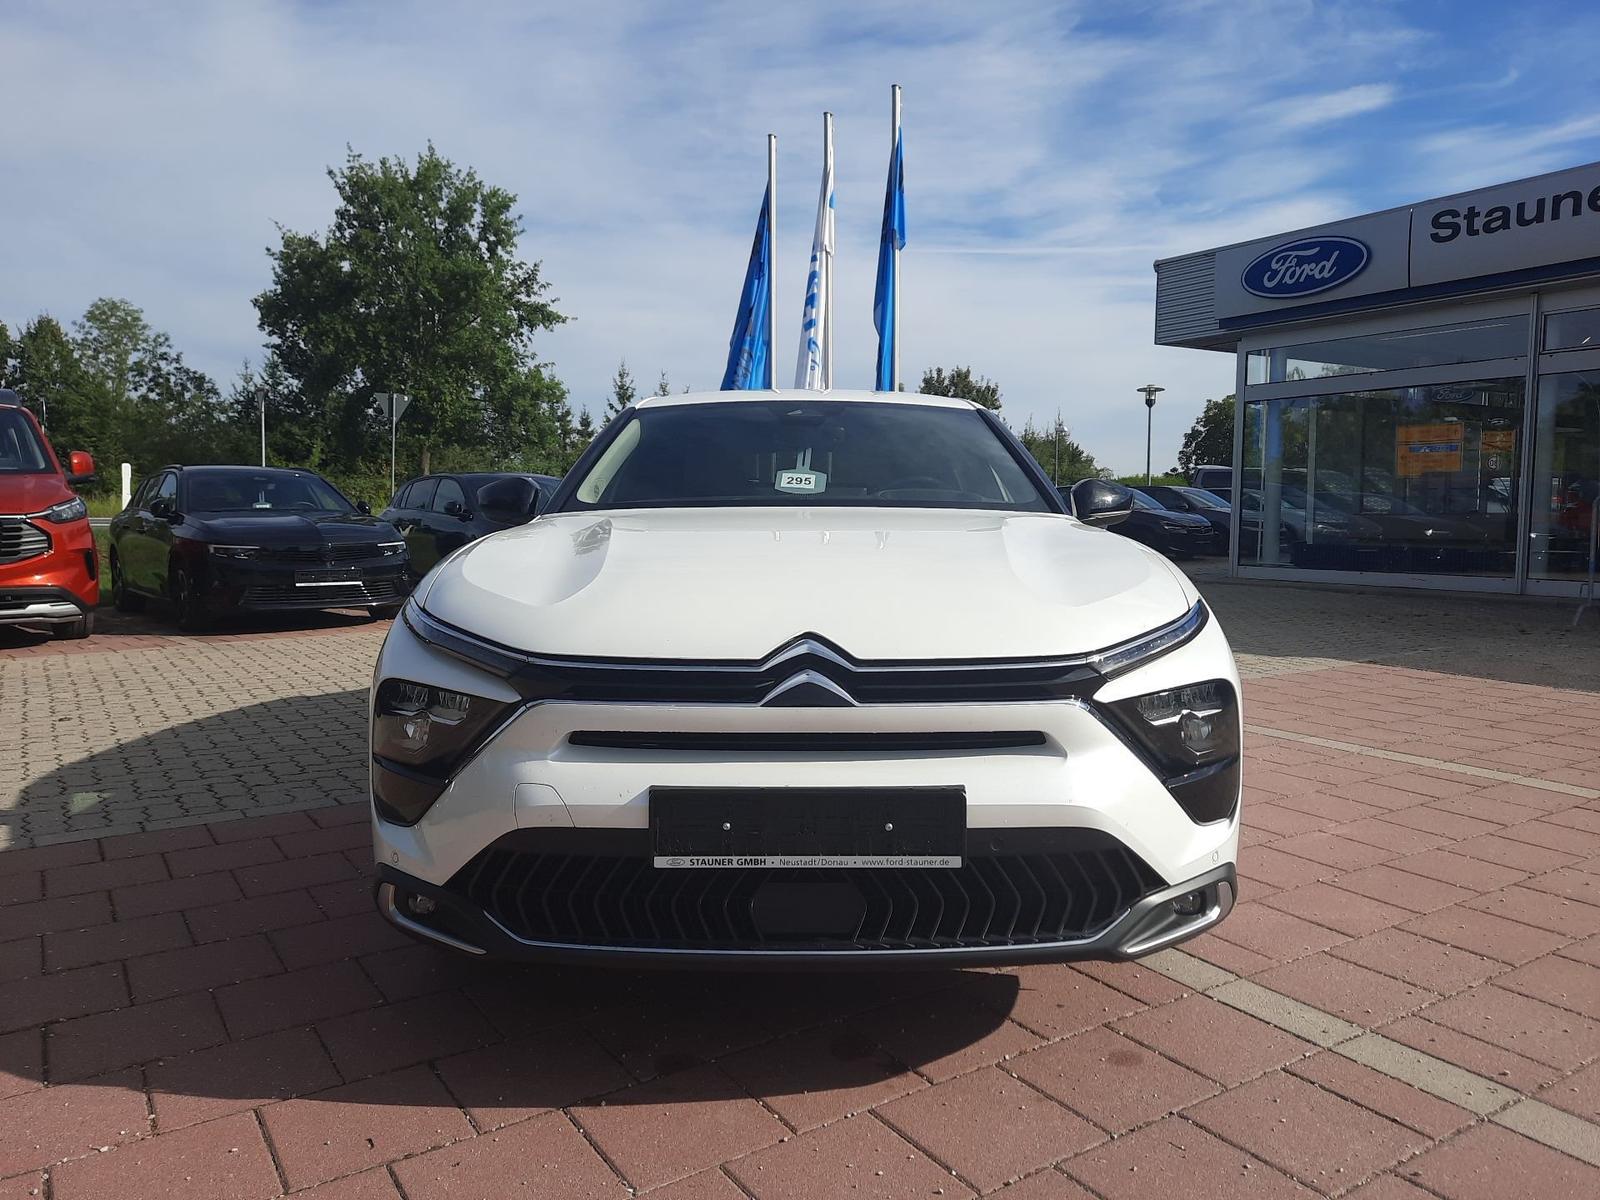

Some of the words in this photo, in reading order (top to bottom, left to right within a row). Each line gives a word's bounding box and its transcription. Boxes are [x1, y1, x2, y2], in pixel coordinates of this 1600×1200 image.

[1263, 247, 1340, 288] Ford
[786, 476, 812, 485] 295
[689, 858, 734, 866] STAUNER
[737, 858, 767, 866] GMBH
[779, 858, 849, 867] Neustadt/Donau
[861, 858, 950, 867] www.ford-stauner.de
